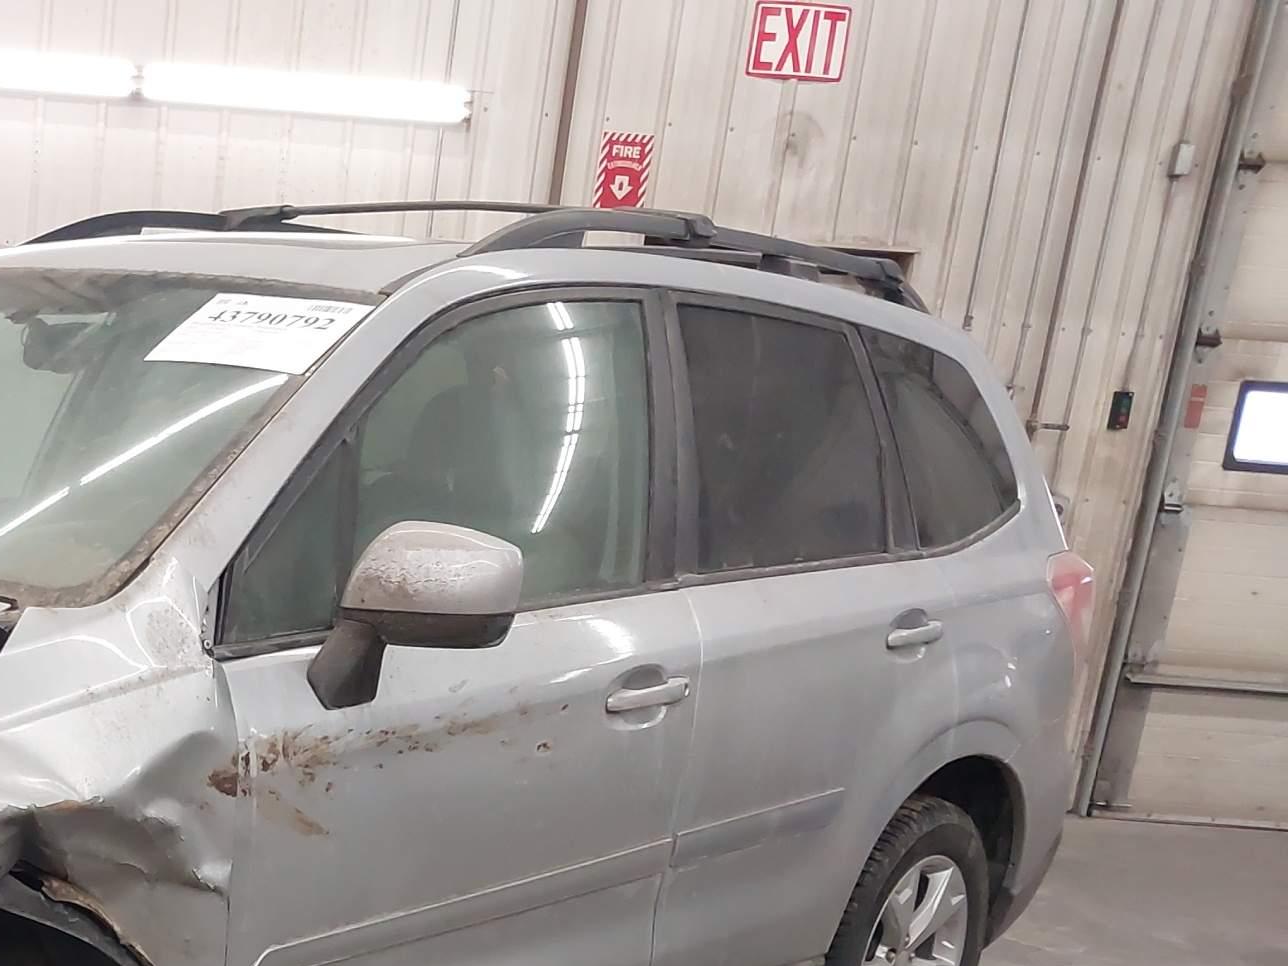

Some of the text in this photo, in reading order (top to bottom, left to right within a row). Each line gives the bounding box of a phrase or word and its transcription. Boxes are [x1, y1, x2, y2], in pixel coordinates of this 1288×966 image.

[751, 7, 847, 76] EXIT
[612, 144, 642, 159] FIRE
[207, 309, 337, 330] 43790792
